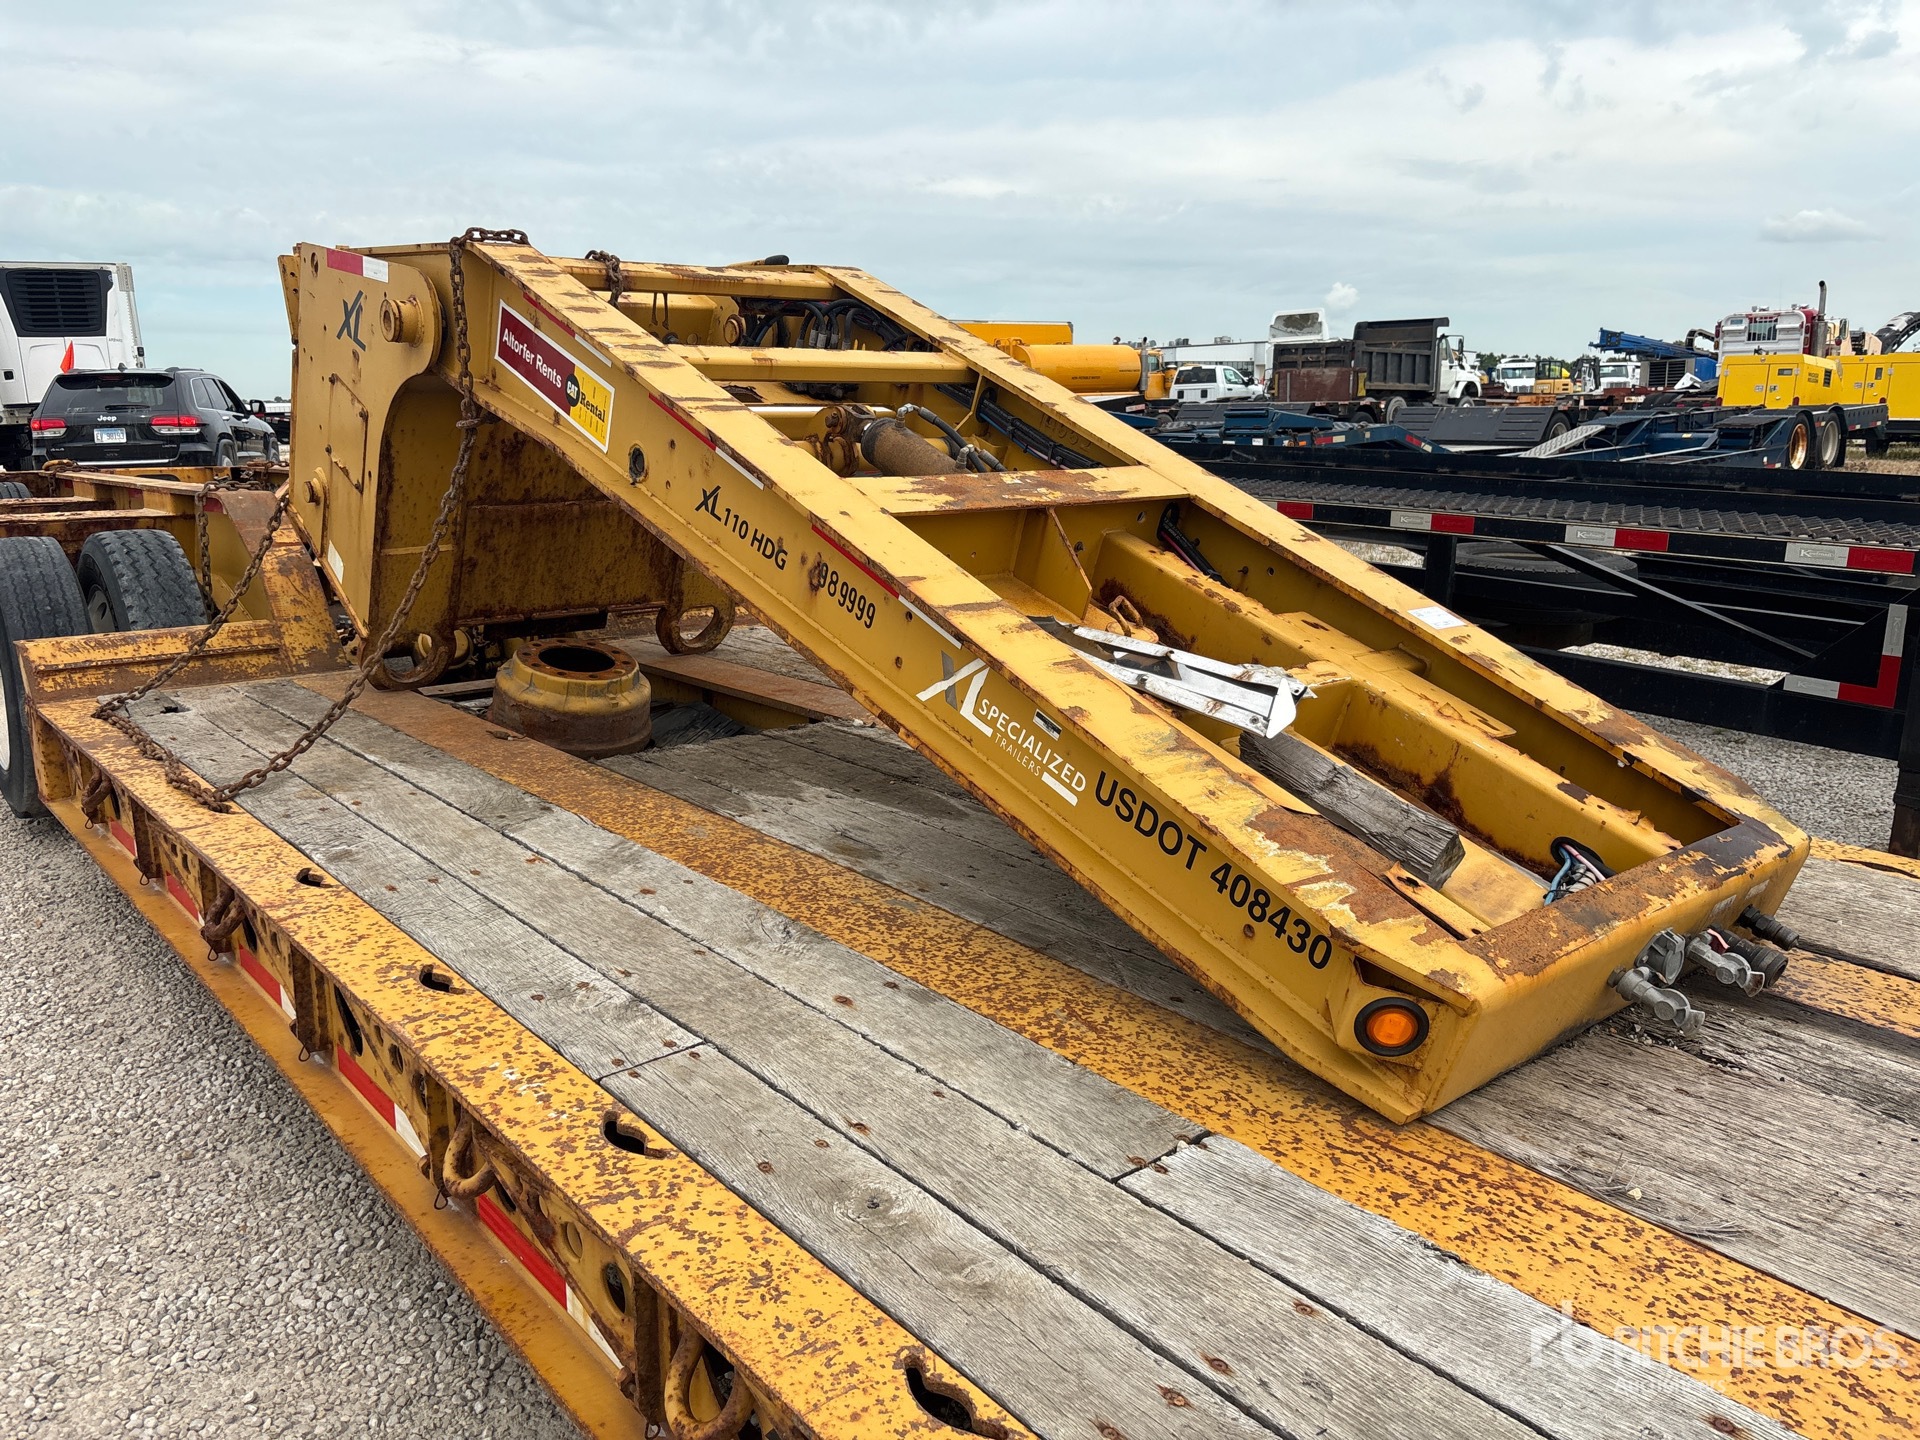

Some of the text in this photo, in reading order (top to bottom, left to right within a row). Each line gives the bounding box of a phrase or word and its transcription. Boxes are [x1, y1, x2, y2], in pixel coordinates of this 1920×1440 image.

[336, 290, 366, 352] XL
[502, 327, 562, 389] Altorfer Rents
[566, 381, 579, 400] CAT
[580, 391, 606, 423] Rental
[750, 528, 789, 571] HDG
[819, 562, 876, 630] 989999
[915, 651, 993, 738] XL
[979, 697, 1087, 793] SPECIALIZED
[994, 732, 1042, 778] TRAILERS
[1094, 770, 1333, 970] USDOT 408430
